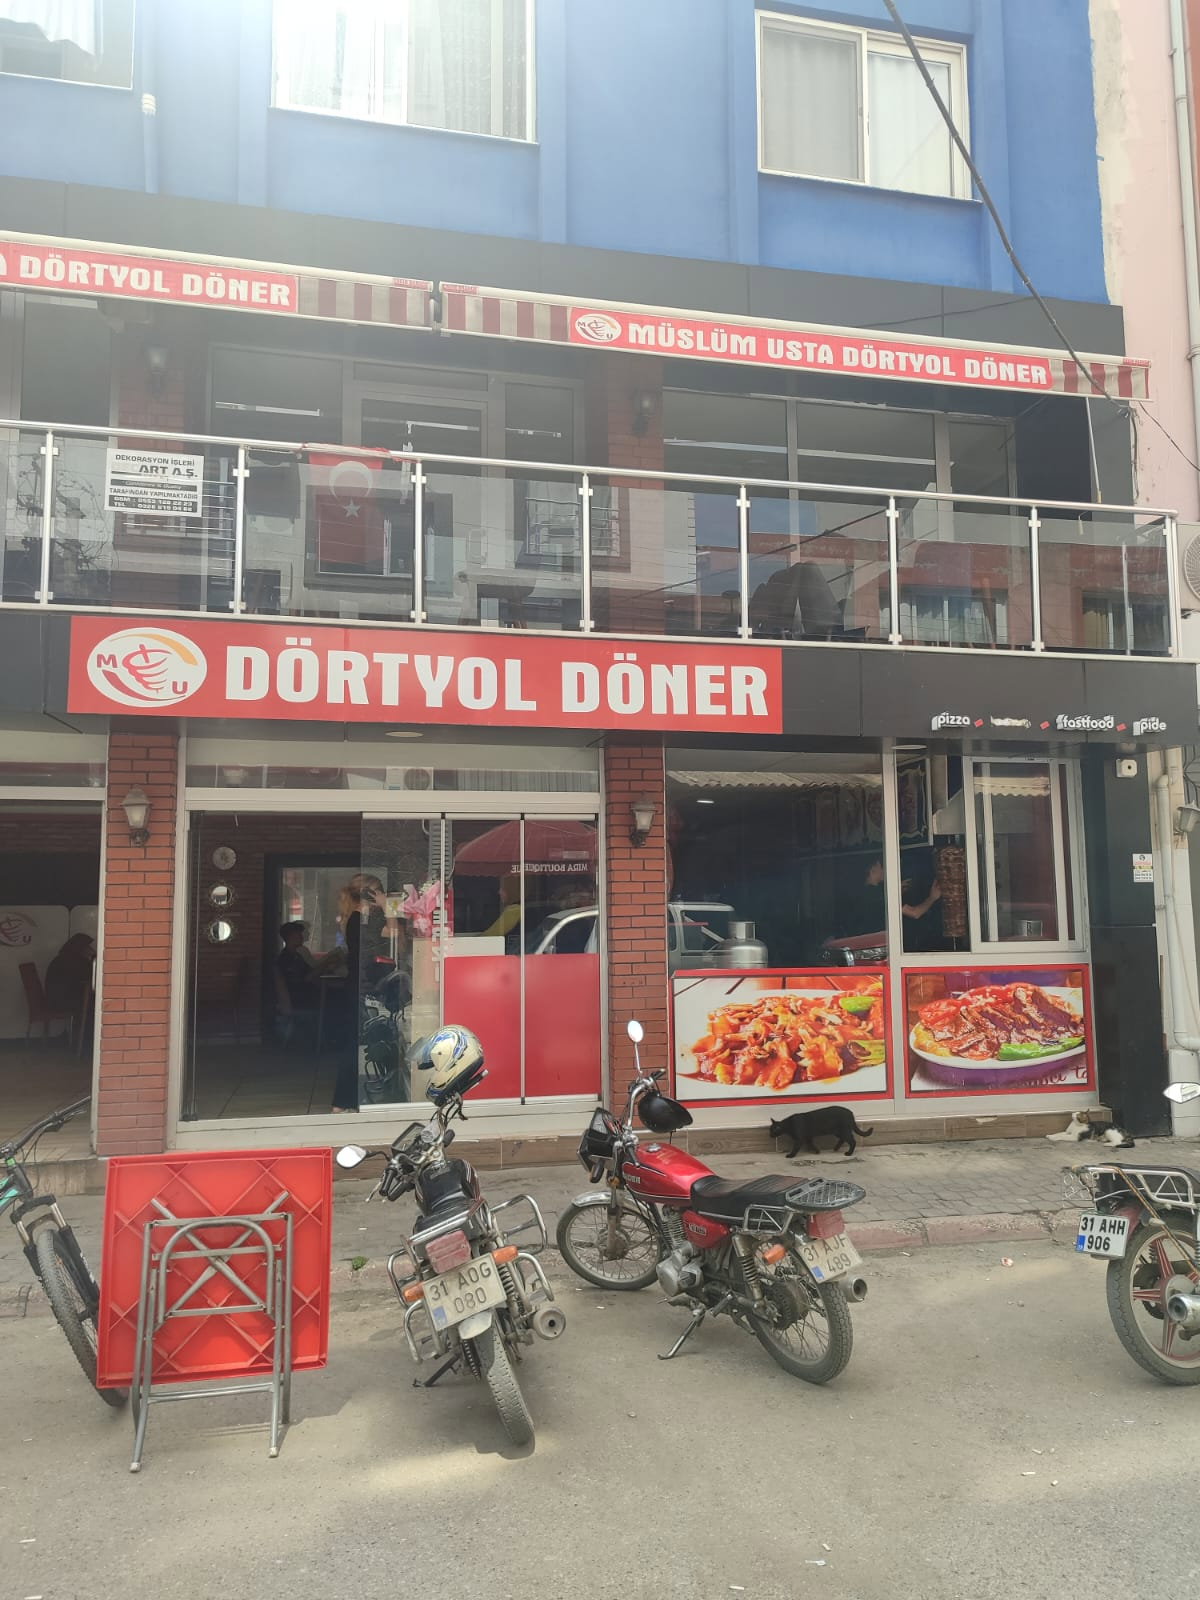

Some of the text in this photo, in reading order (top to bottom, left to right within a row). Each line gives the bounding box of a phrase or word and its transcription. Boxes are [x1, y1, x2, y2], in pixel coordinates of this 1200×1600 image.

[20, 253, 170, 293] DÖRTYOL
[182, 272, 291, 306] DÖNER
[628, 322, 1047, 385] MÜSLÜM USTA DÖRTYOL DÖNER
[115, 454, 169, 465] DEKORASYON
[139, 464, 168, 475] ART
[96, 653, 118, 669] M
[225, 636, 768, 716] DÖRTYOL DÖNER
[171, 680, 188, 695] U
[934, 711, 970, 729] pizza
[1059, 714, 1115, 731] fastfood
[1136, 716, 1167, 735] pide
[1081, 1216, 1126, 1236] 31 AHH
[1087, 1234, 1111, 1251] 906
[803, 1244, 820, 1262] 31
[827, 1252, 852, 1273] 489
[430, 1261, 492, 1301] 31 AOG
[454, 1286, 487, 1313] 080
